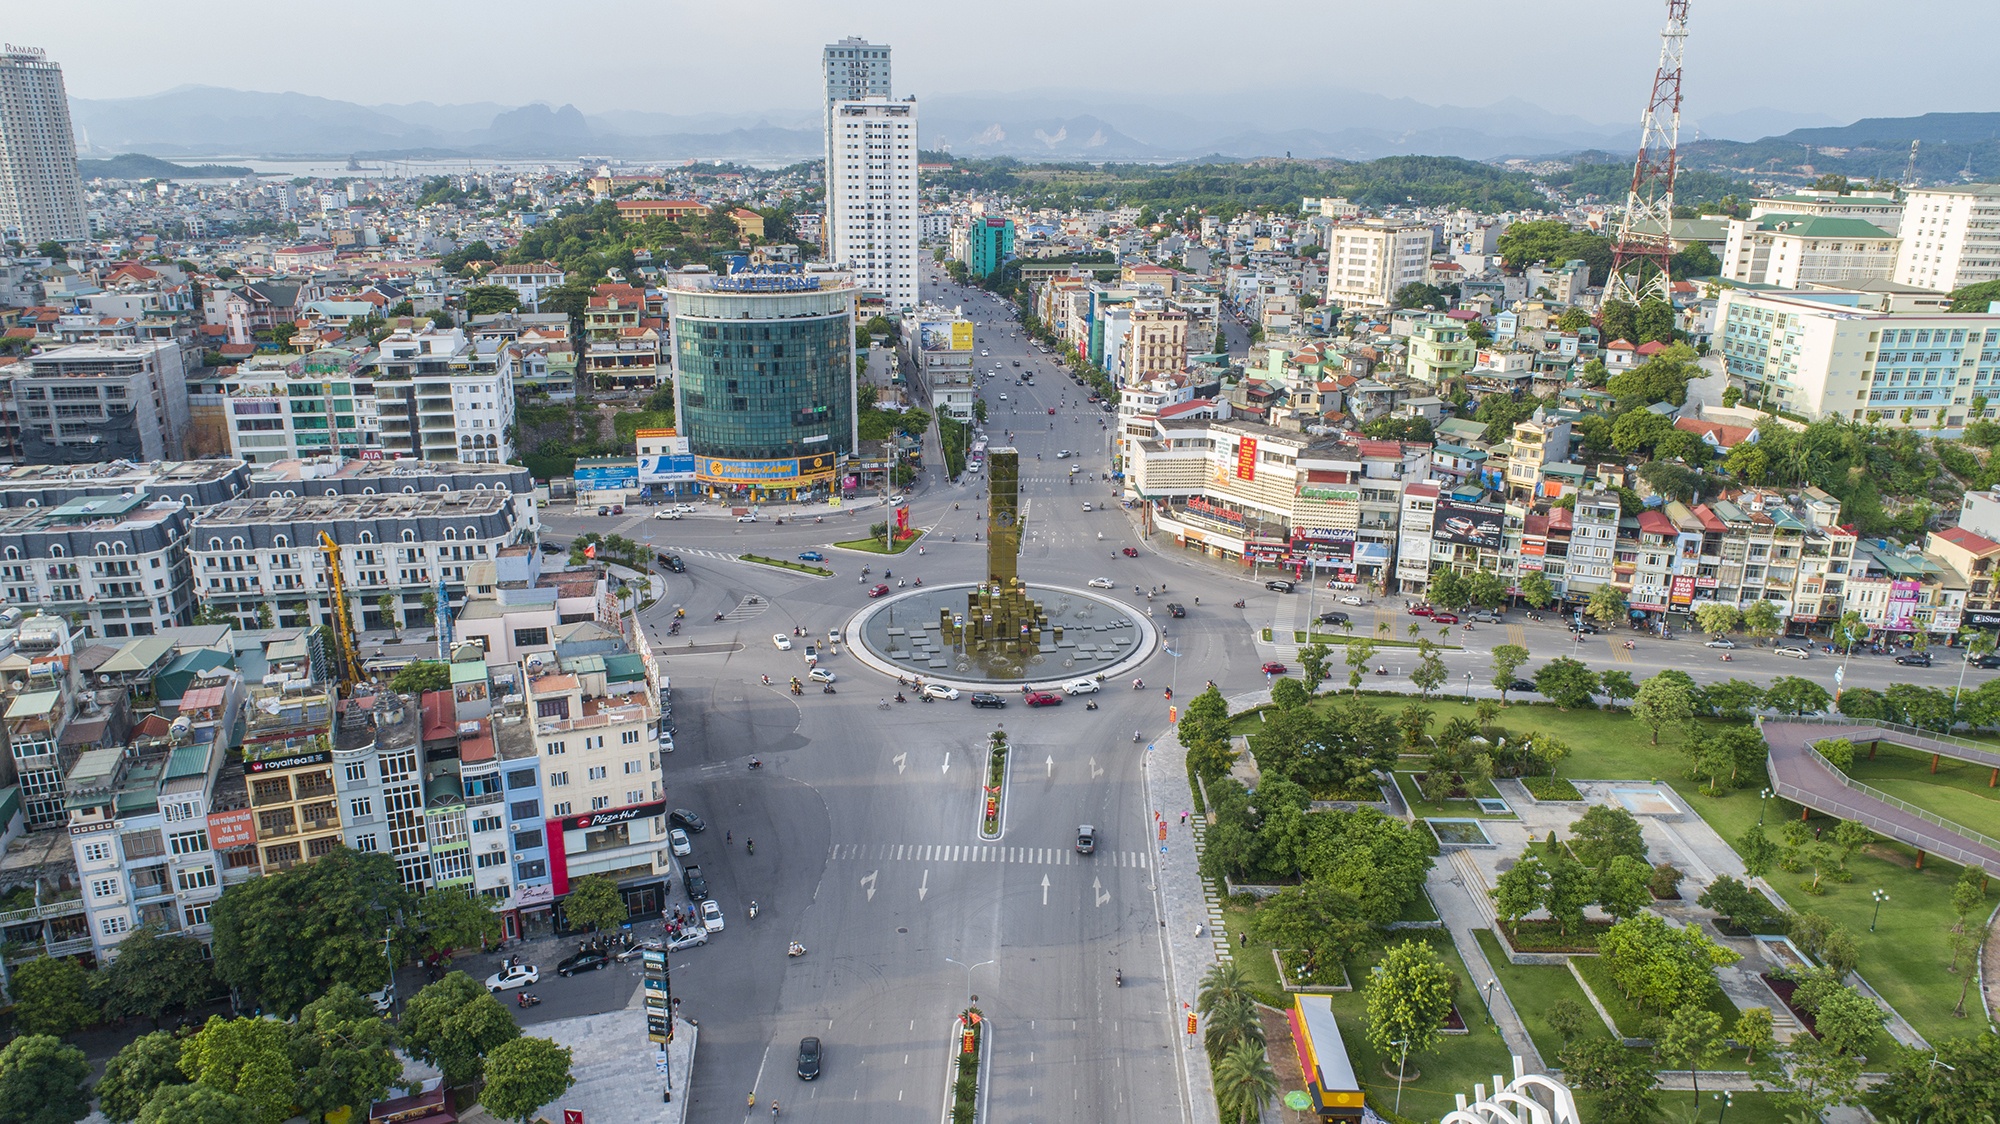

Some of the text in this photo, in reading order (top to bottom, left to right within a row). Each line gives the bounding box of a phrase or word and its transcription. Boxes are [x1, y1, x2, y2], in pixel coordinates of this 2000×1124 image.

[4, 42, 47, 56] RAMADA
[749, 263, 804, 275] VNPT
[709, 276, 820, 292] VINAPHONE
[362, 451, 381, 460] AIA
[763, 465, 791, 473] XANH
[1295, 485, 1359, 500] Kangaroo
[1312, 527, 1354, 537] XINGFA
[264, 757, 308, 769] royaltea
[591, 809, 640, 826] Pizza Hut
[221, 824, 242, 834] VÀ IN
